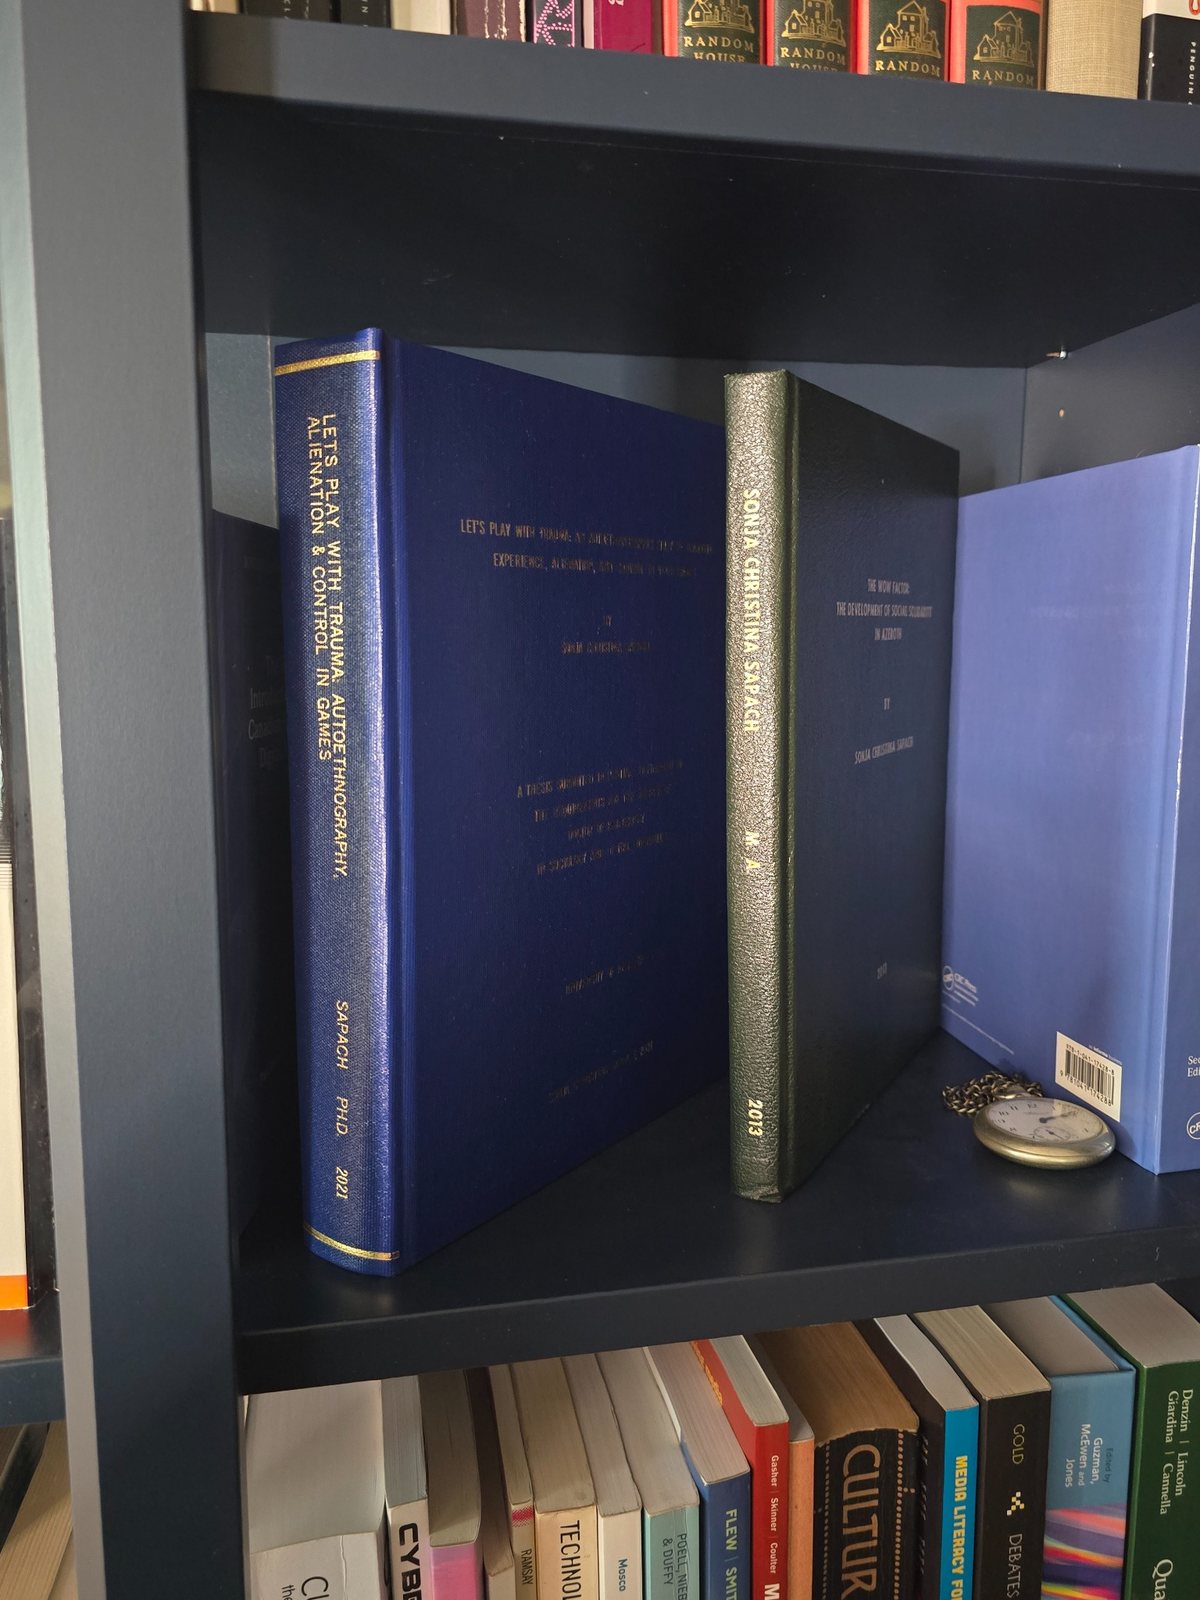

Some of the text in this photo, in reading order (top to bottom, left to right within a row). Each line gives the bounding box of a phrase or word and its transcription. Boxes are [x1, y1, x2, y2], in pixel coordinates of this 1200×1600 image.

[684, 36, 754, 53] RANDOM
[780, 47, 846, 65] RANDOM
[1188, 41, 1197, 94] PENGUIN
[875, 60, 941, 77] RANDOM
[972, 69, 1034, 85] RANDOM
[325, 478, 340, 528] PLAY
[743, 488, 761, 550] SONJA
[460, 518, 486, 535] LET'S
[489, 521, 511, 537] PLAY
[515, 524, 535, 539] WITH
[307, 416, 332, 762] ALIENATION & CONTROL IN GAMES
[327, 540, 342, 592] WITH
[743, 556, 761, 653] CHRISTINA
[836, 601, 847, 616] THE
[847, 602, 883, 617] DEVELOPMENT
[884, 604, 890, 616] OF
[744, 660, 761, 732] SAPACH
[335, 1000, 349, 1070] SAPACH
[748, 1099, 763, 1137] 2013
[335, 1167, 349, 1199] 2021
[1012, 1423, 1025, 1465] GOLD
[1079, 1423, 1091, 1469] McEwen
[1090, 1437, 1103, 1485] Guzman,
[1160, 1390, 1180, 1515] Giardina Cannella
[1175, 1389, 1194, 1496] Denzin Lincoln
[1065, 1458, 1075, 1488] Jones
[725, 1508, 738, 1551] FLEW
[769, 1455, 779, 1574] Gasher Skinner Coulter
[841, 1443, 881, 1600] CULTUR
[950, 1455, 968, 1600] MEDIA LITERACY FO
[521, 1548, 533, 1585] RAMSAY
[618, 1558, 628, 1592] Mosco
[662, 1538, 674, 1585] & DUFFY
[677, 1533, 688, 1574] POELL,
[1007, 1533, 1023, 1599] DEBATES
